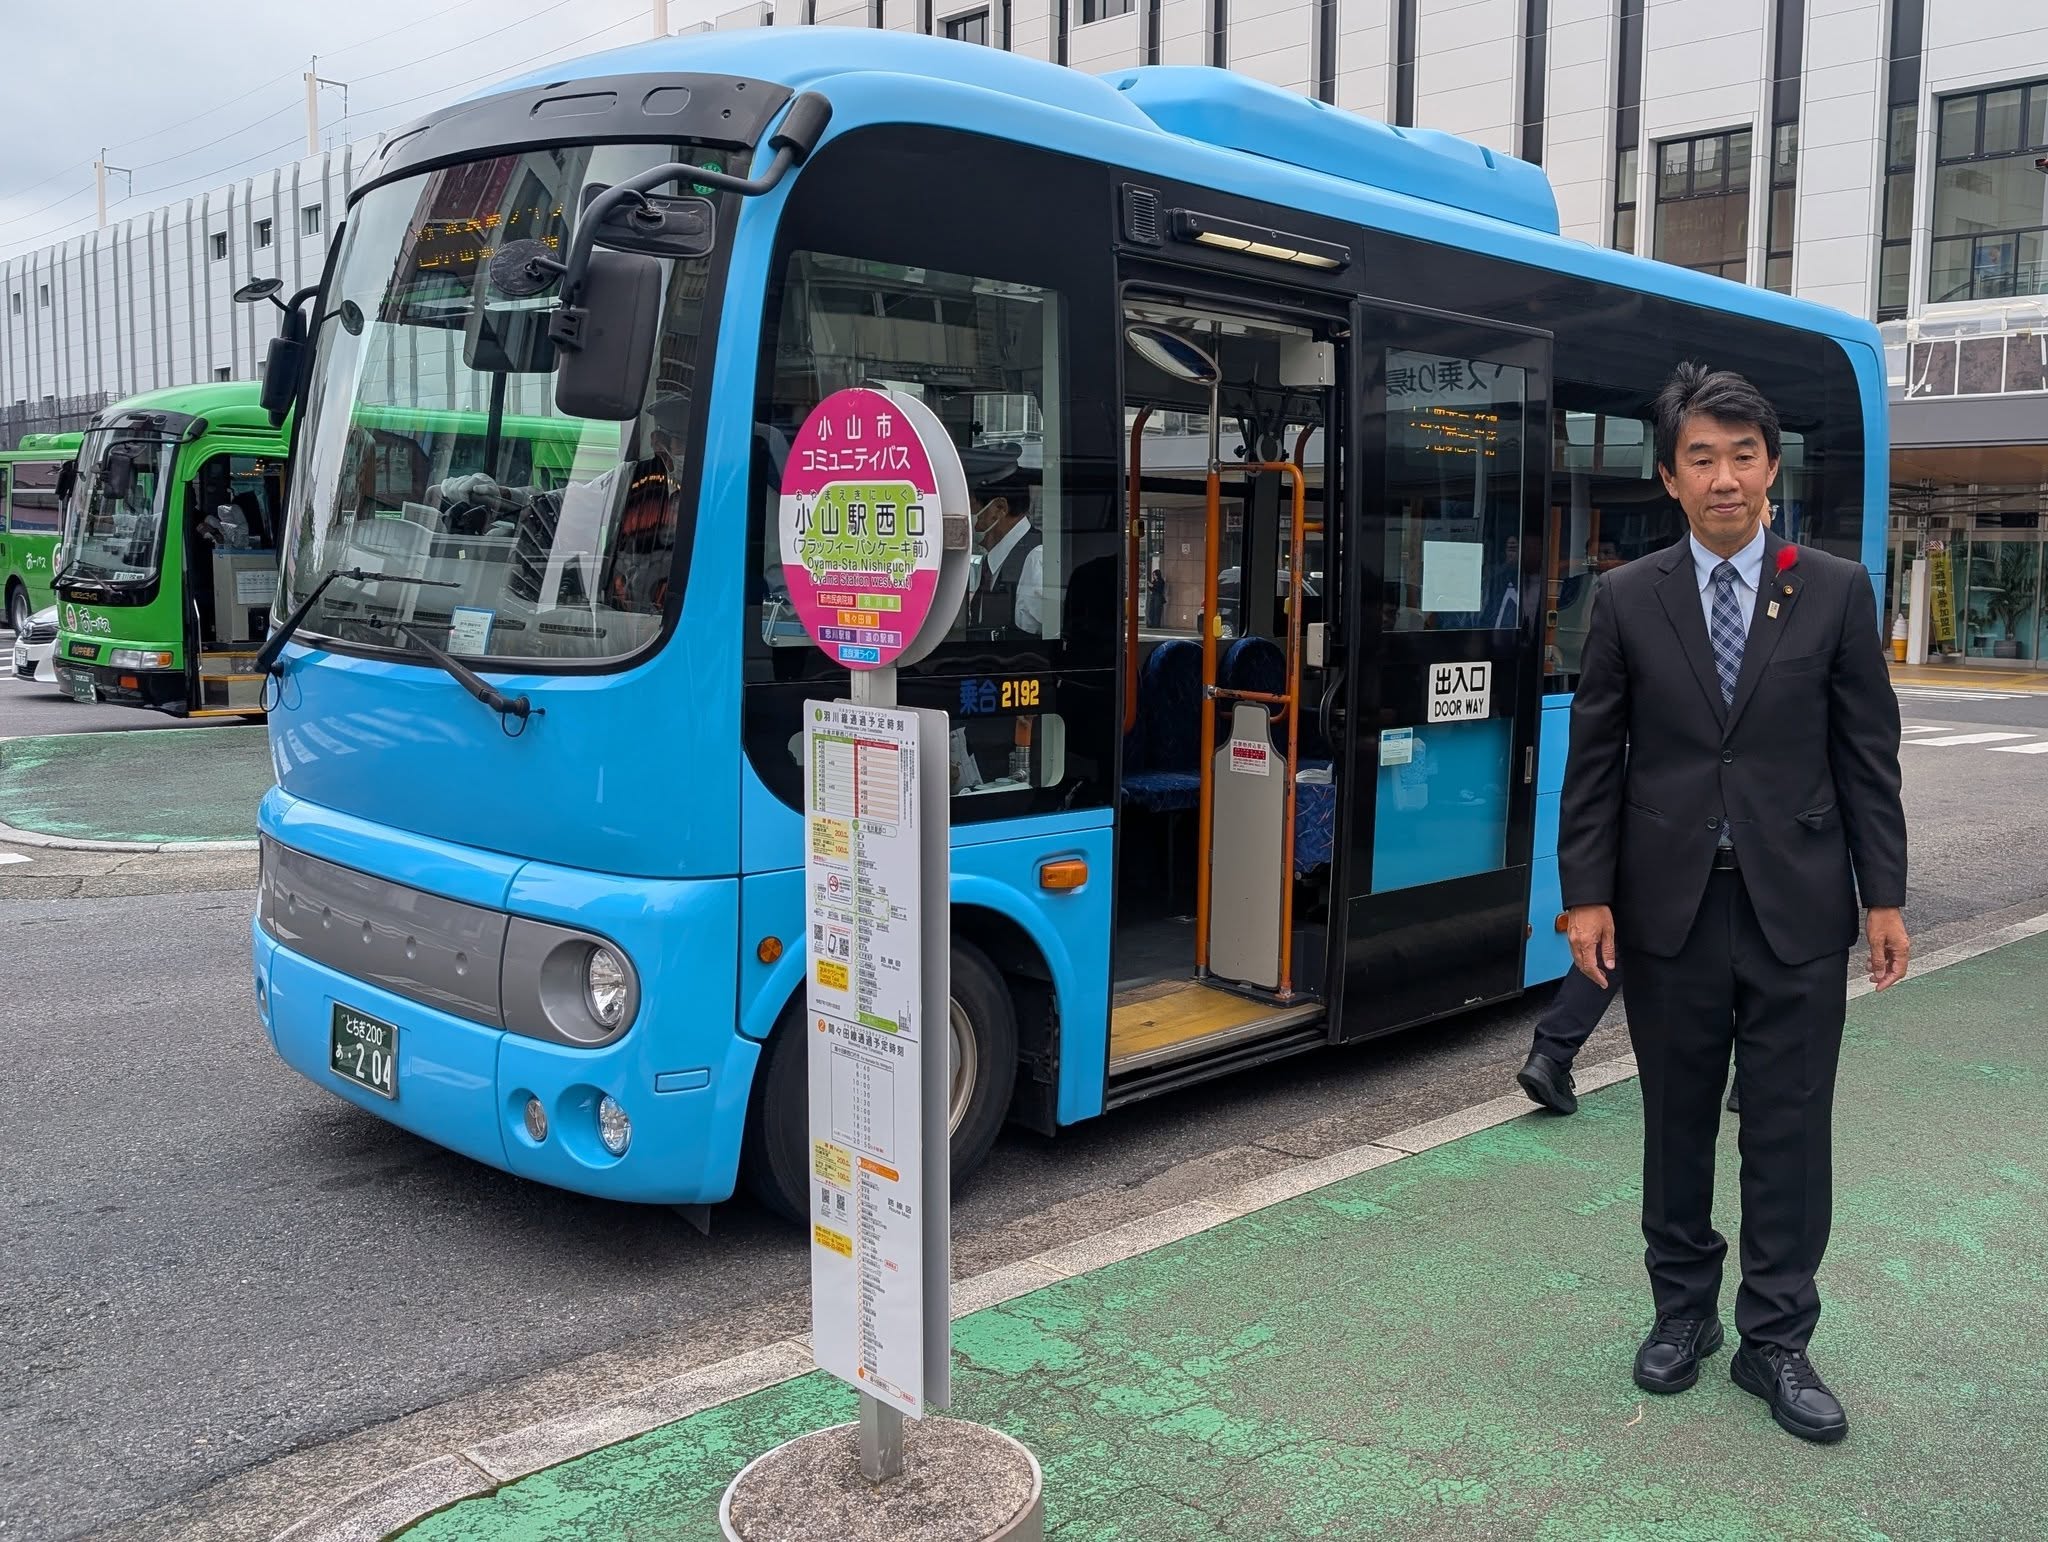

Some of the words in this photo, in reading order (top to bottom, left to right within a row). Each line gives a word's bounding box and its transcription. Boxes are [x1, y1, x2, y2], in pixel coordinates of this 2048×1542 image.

[817, 412, 892, 441] 小山市
[795, 488, 924, 501] おやまえきにしぐち
[795, 502, 925, 537] 小山駅西口
[810, 572, 839, 587] (Oyama
[840, 574, 869, 587] Station
[871, 577, 891, 588] west
[894, 577, 912, 590] exit)
[1435, 666, 1485, 695] 出入口
[960, 679, 998, 714] 乗合
[1002, 680, 1039, 708] 2192
[1435, 700, 1461, 717] DOOR
[1466, 698, 1484, 715] WAY
[336, 1042, 343, 1060] あ
